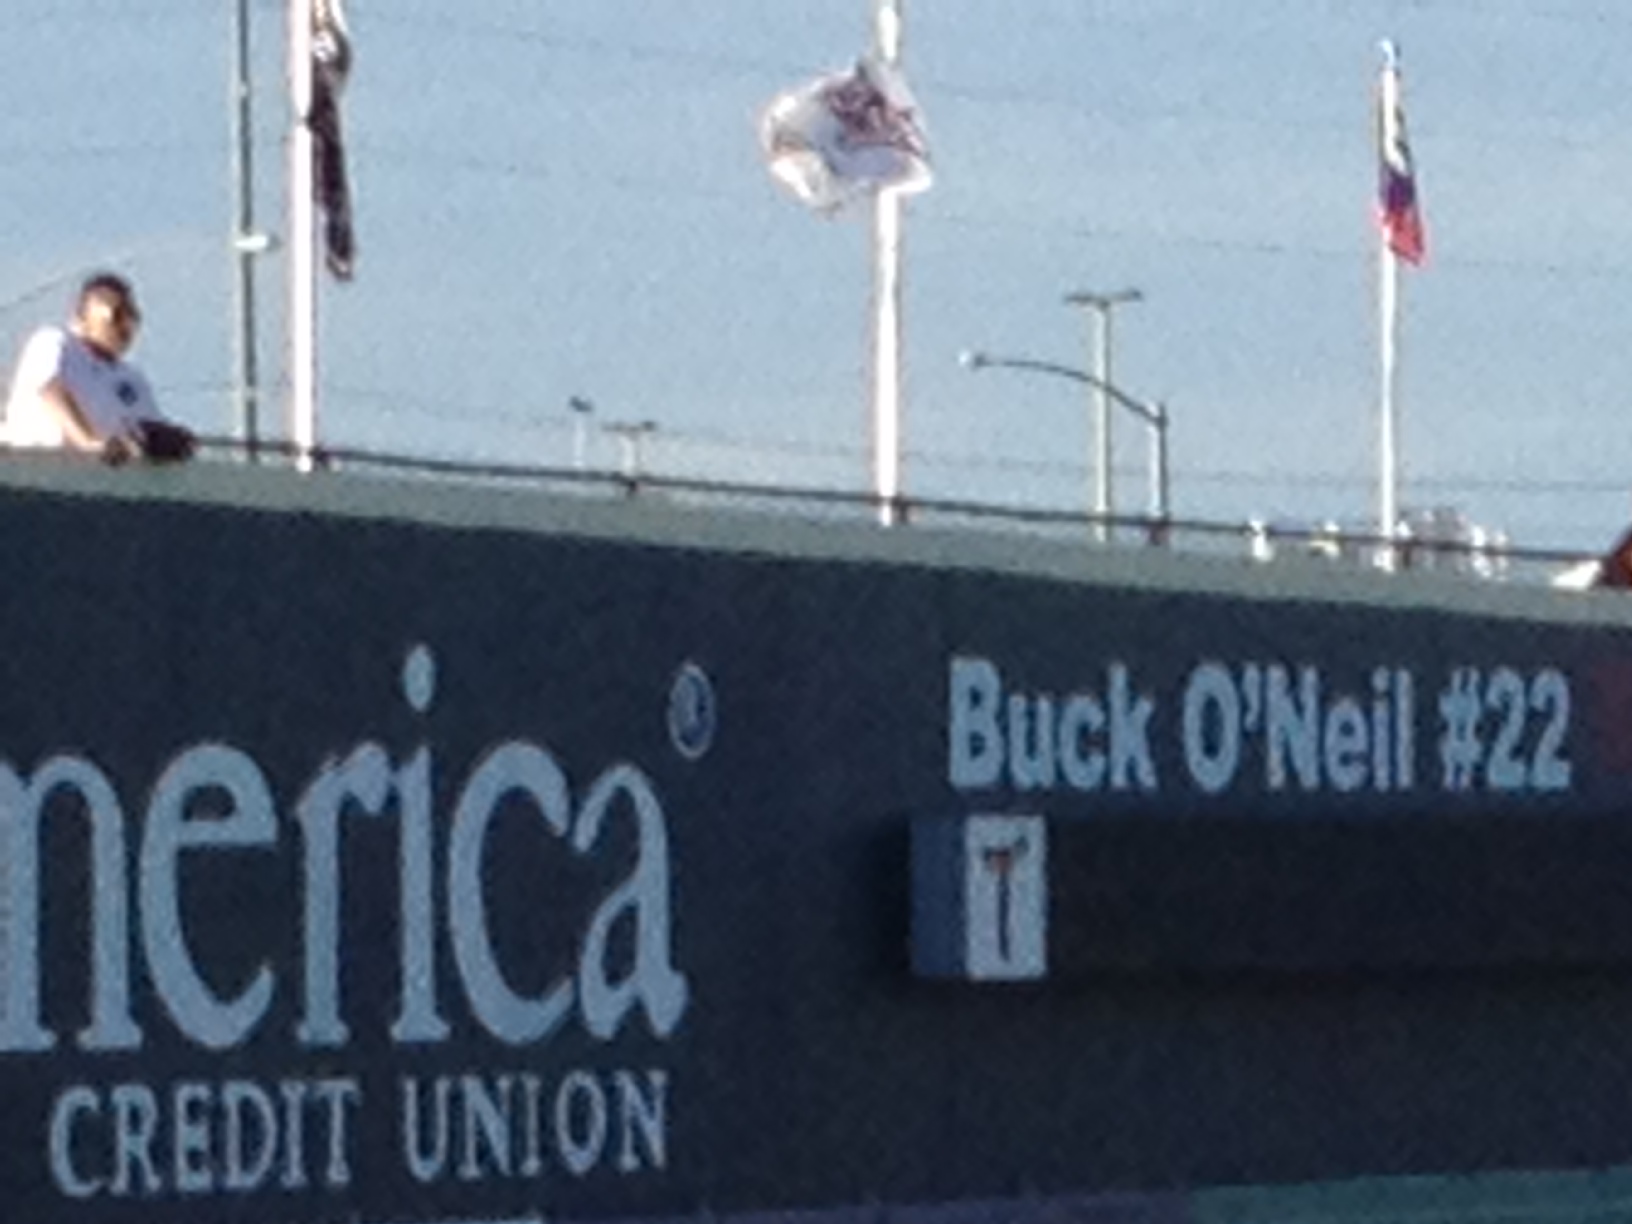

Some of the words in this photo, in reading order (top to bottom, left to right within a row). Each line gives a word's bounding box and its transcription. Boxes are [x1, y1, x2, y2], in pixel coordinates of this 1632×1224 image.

[949, 657, 1158, 789] Buck
[1183, 661, 1412, 792] O'Neil
[1438, 666, 1573, 791] #22
[48, 1077, 362, 1198] CREDIT
[403, 1068, 670, 1182] UNION
